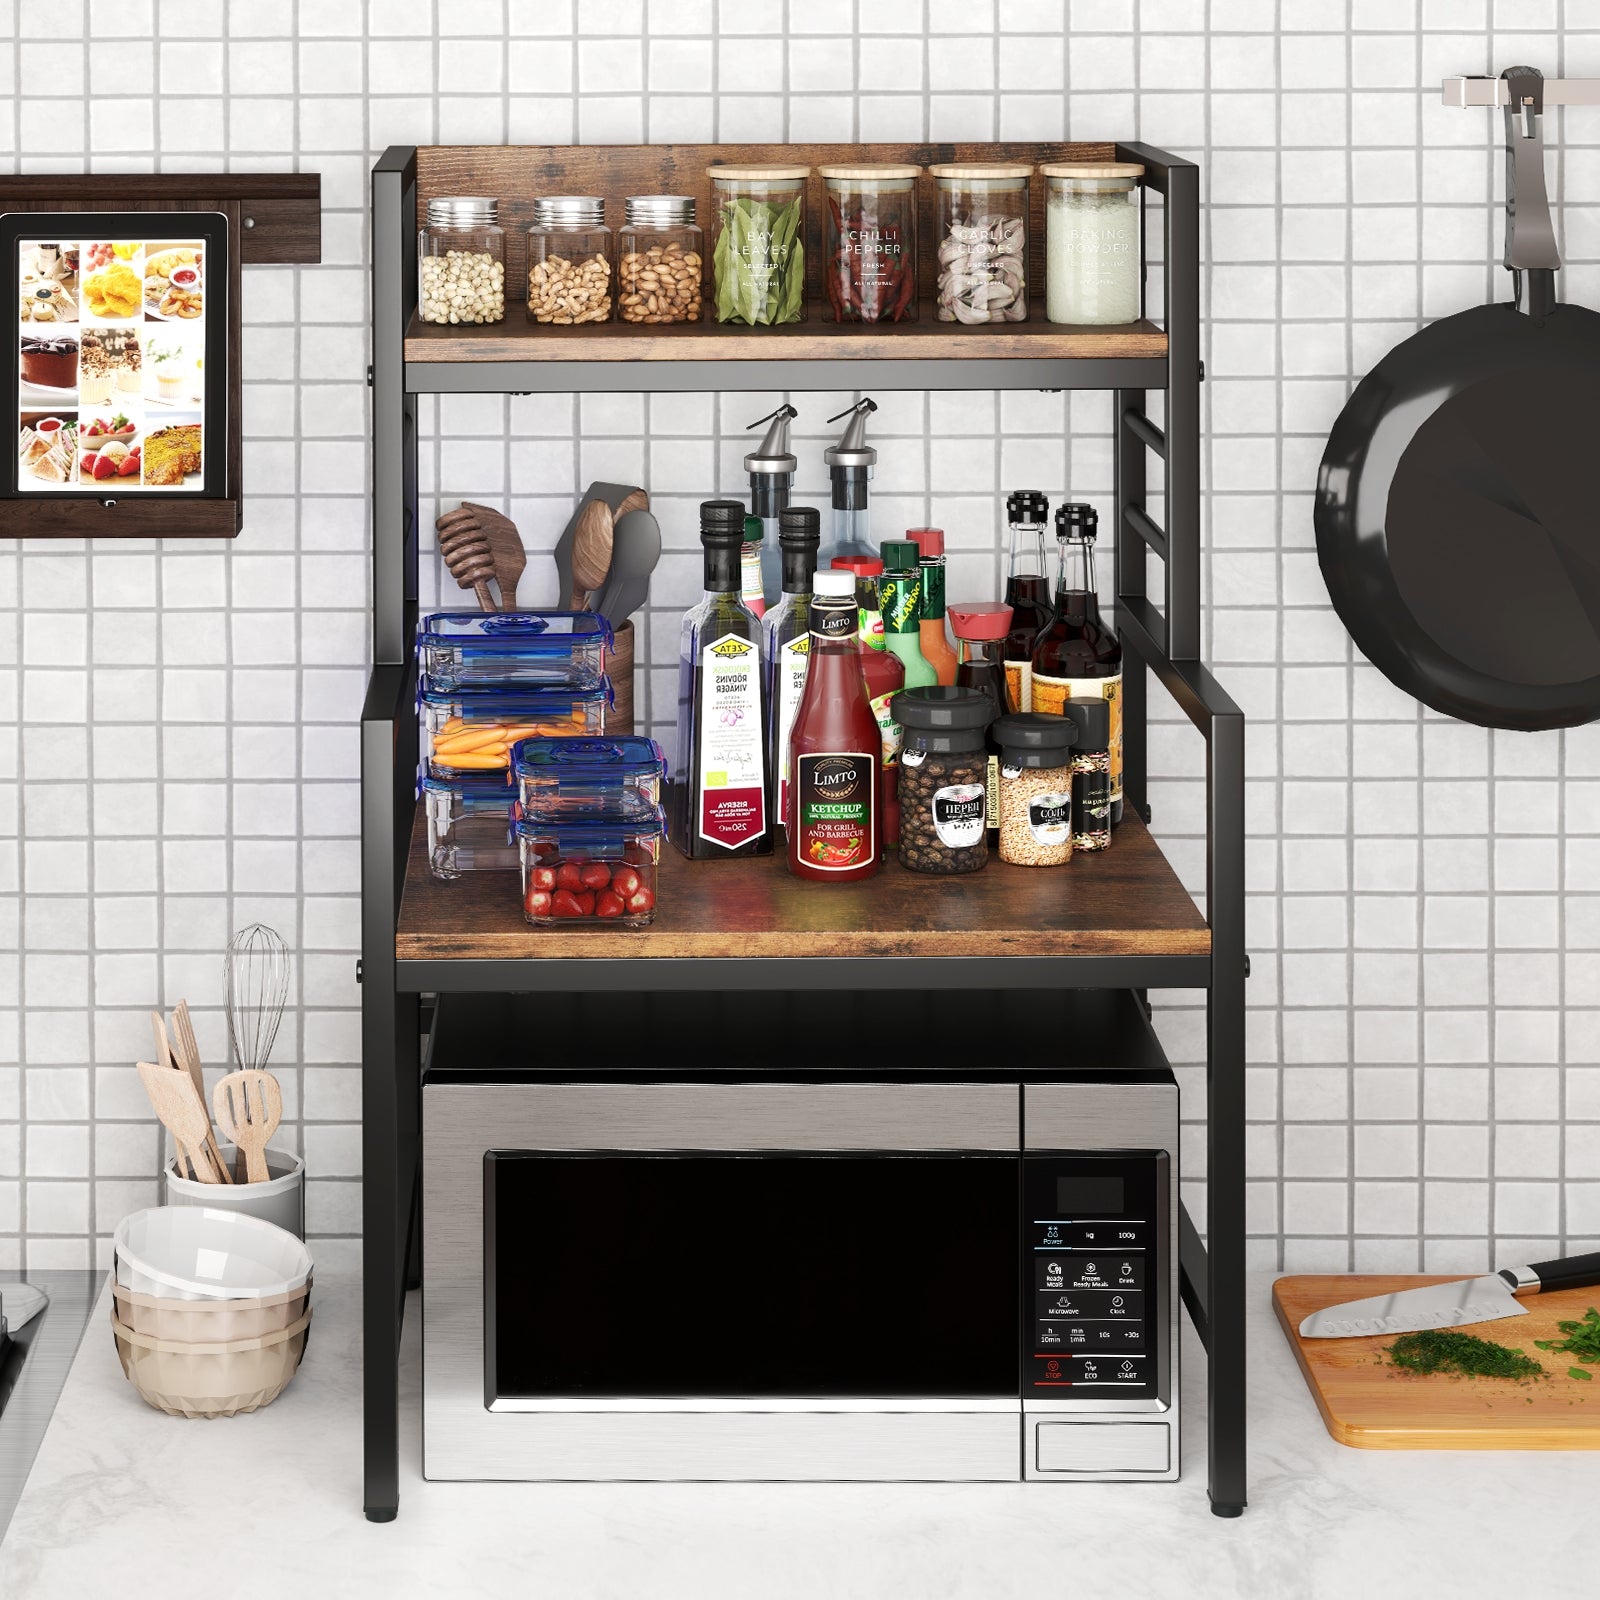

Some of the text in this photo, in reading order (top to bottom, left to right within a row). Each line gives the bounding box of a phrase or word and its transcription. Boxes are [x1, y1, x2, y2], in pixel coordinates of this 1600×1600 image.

[747, 231, 775, 241] BAY
[849, 230, 896, 240] CHILLI
[959, 230, 1012, 240] GARLIC
[736, 245, 787, 255] LEAVES
[845, 244, 901, 254] PEPPER
[958, 244, 1013, 254] CLOVES
[892, 582, 920, 630] JALAPEÑO
[822, 617, 850, 630] LIMTO
[814, 770, 857, 786] LIMTO
[811, 804, 862, 813] KETCHUP
[817, 823, 856, 831] FOR GRILL
[827, 829, 864, 838] BARBECUE
